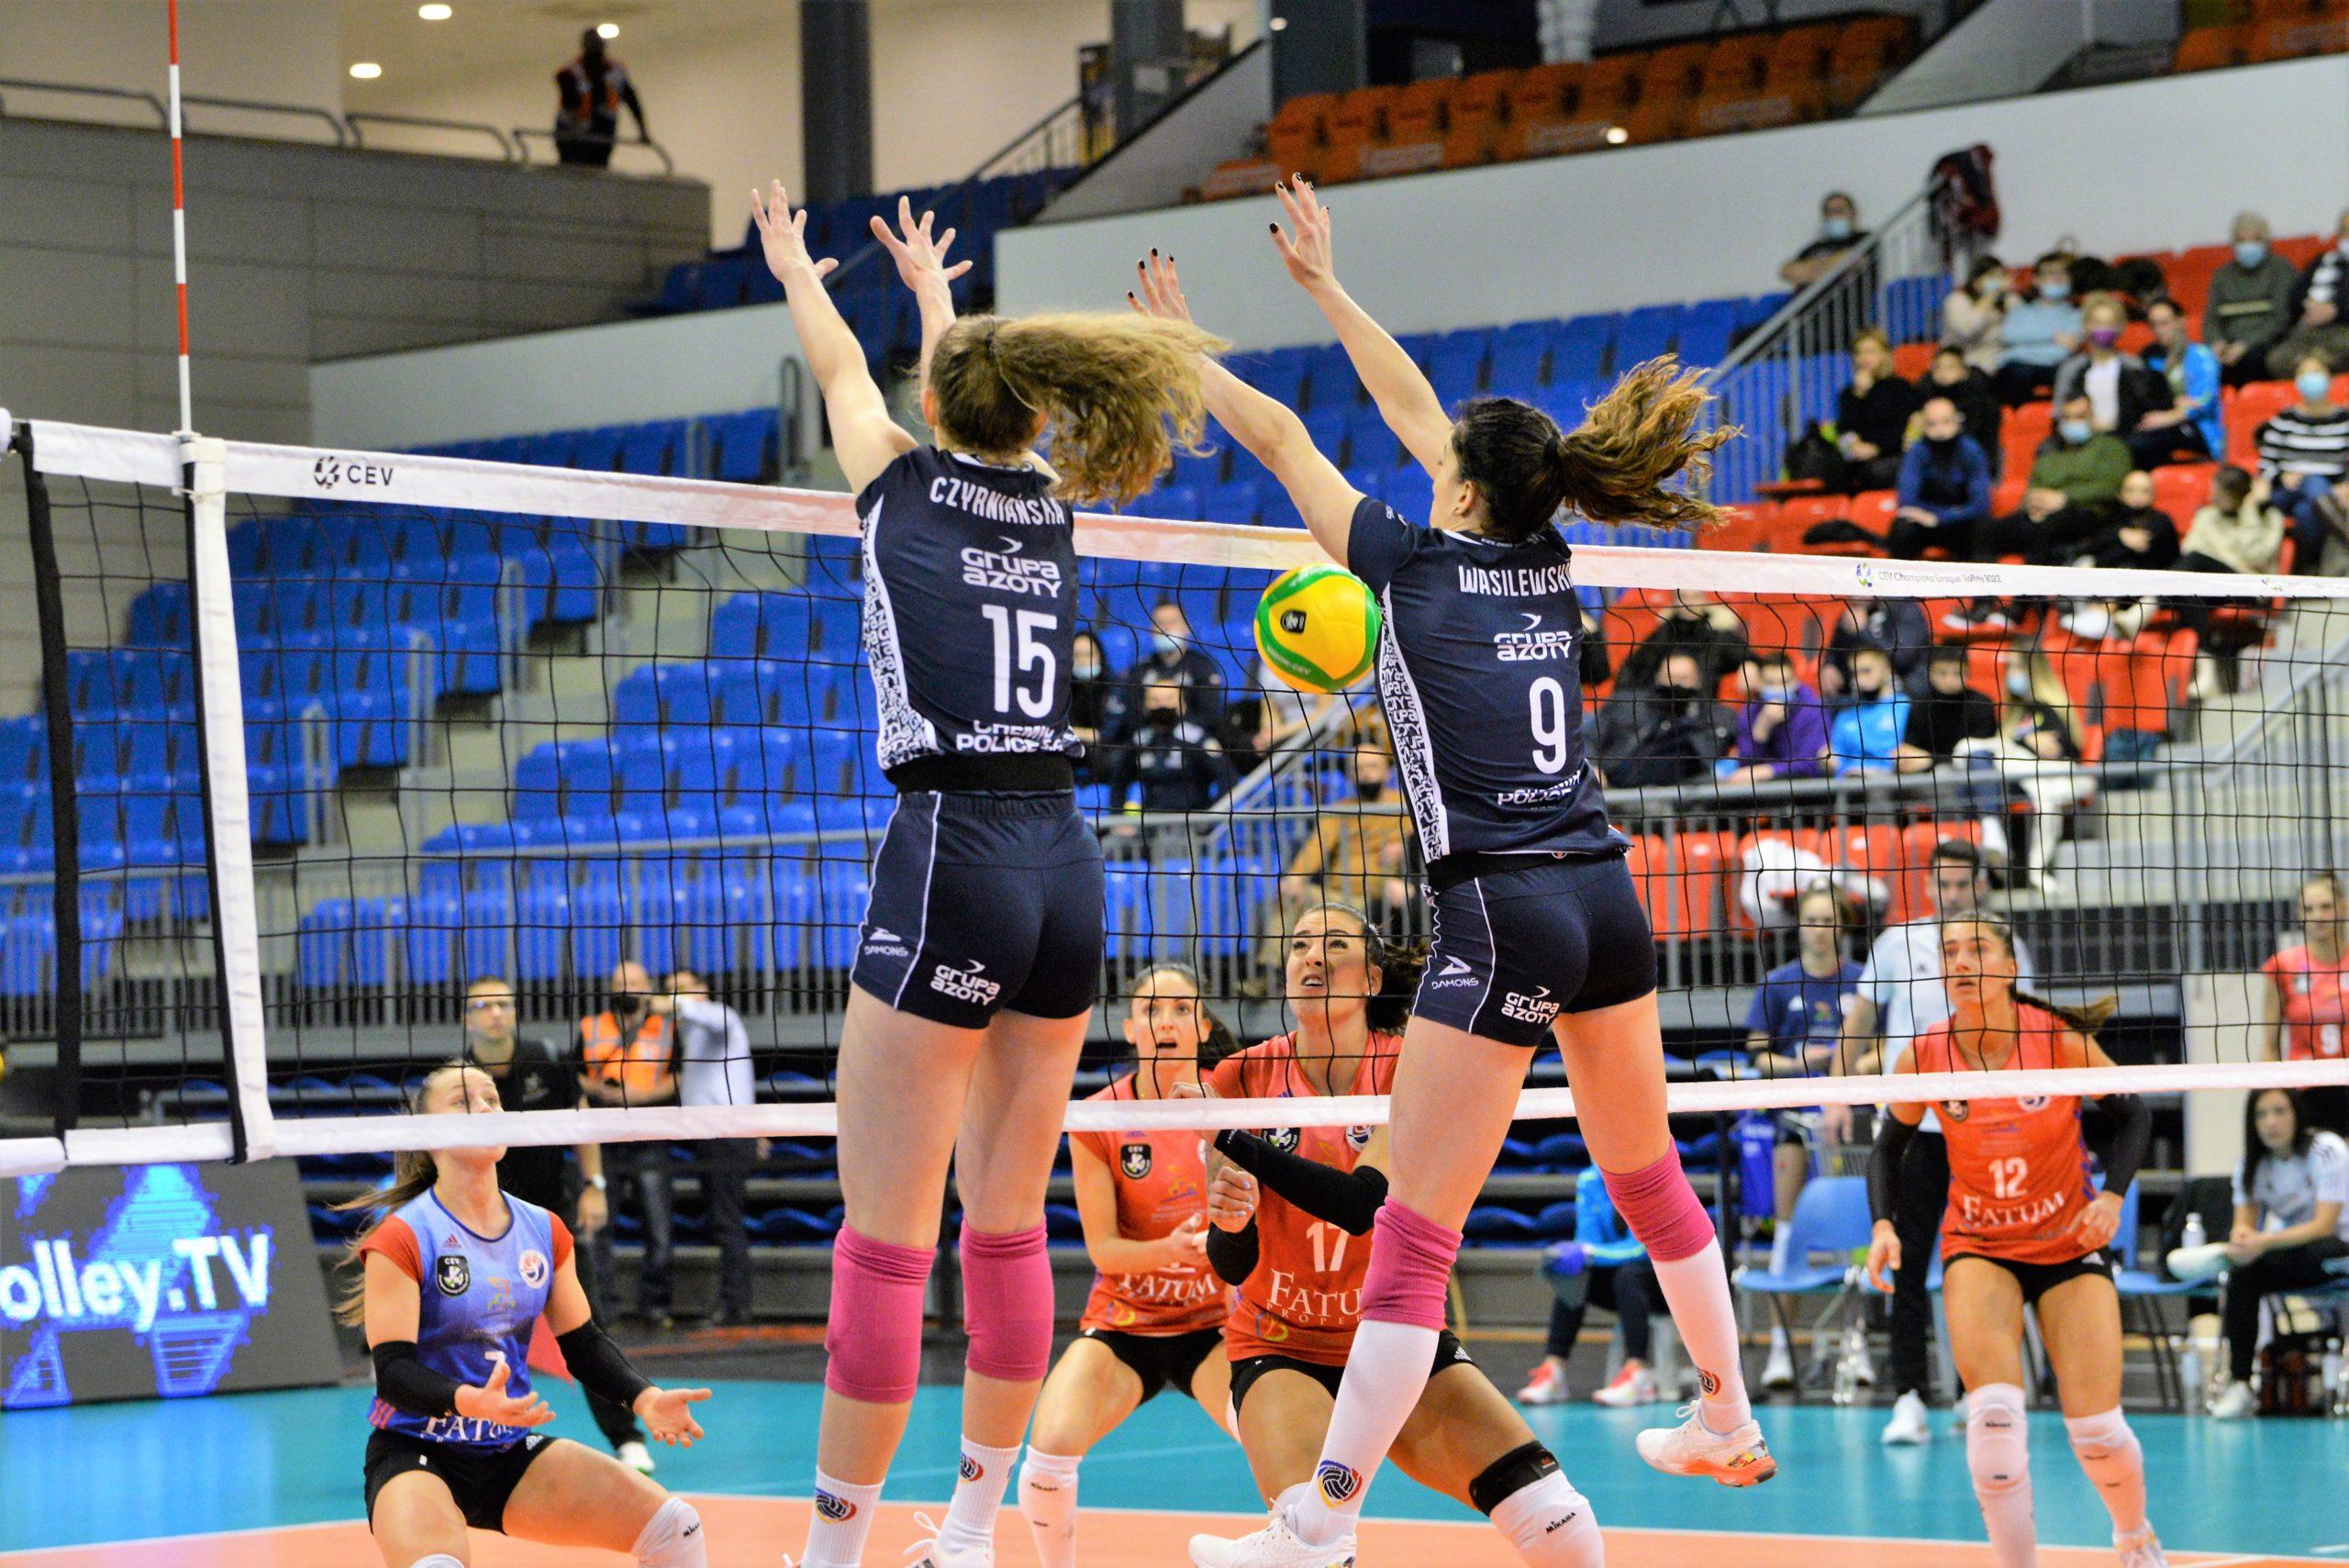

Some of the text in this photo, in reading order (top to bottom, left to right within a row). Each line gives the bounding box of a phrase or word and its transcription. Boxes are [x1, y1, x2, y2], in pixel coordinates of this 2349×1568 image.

[347, 464, 393, 485] CEV
[982, 604, 1058, 718] 15
[1529, 676, 1567, 774] 9
[1431, 977, 1479, 990] DAMONS
[1987, 1156, 2029, 1199] 12
[1963, 1191, 2065, 1226] FATUM
[1306, 1221, 1351, 1273] 17
